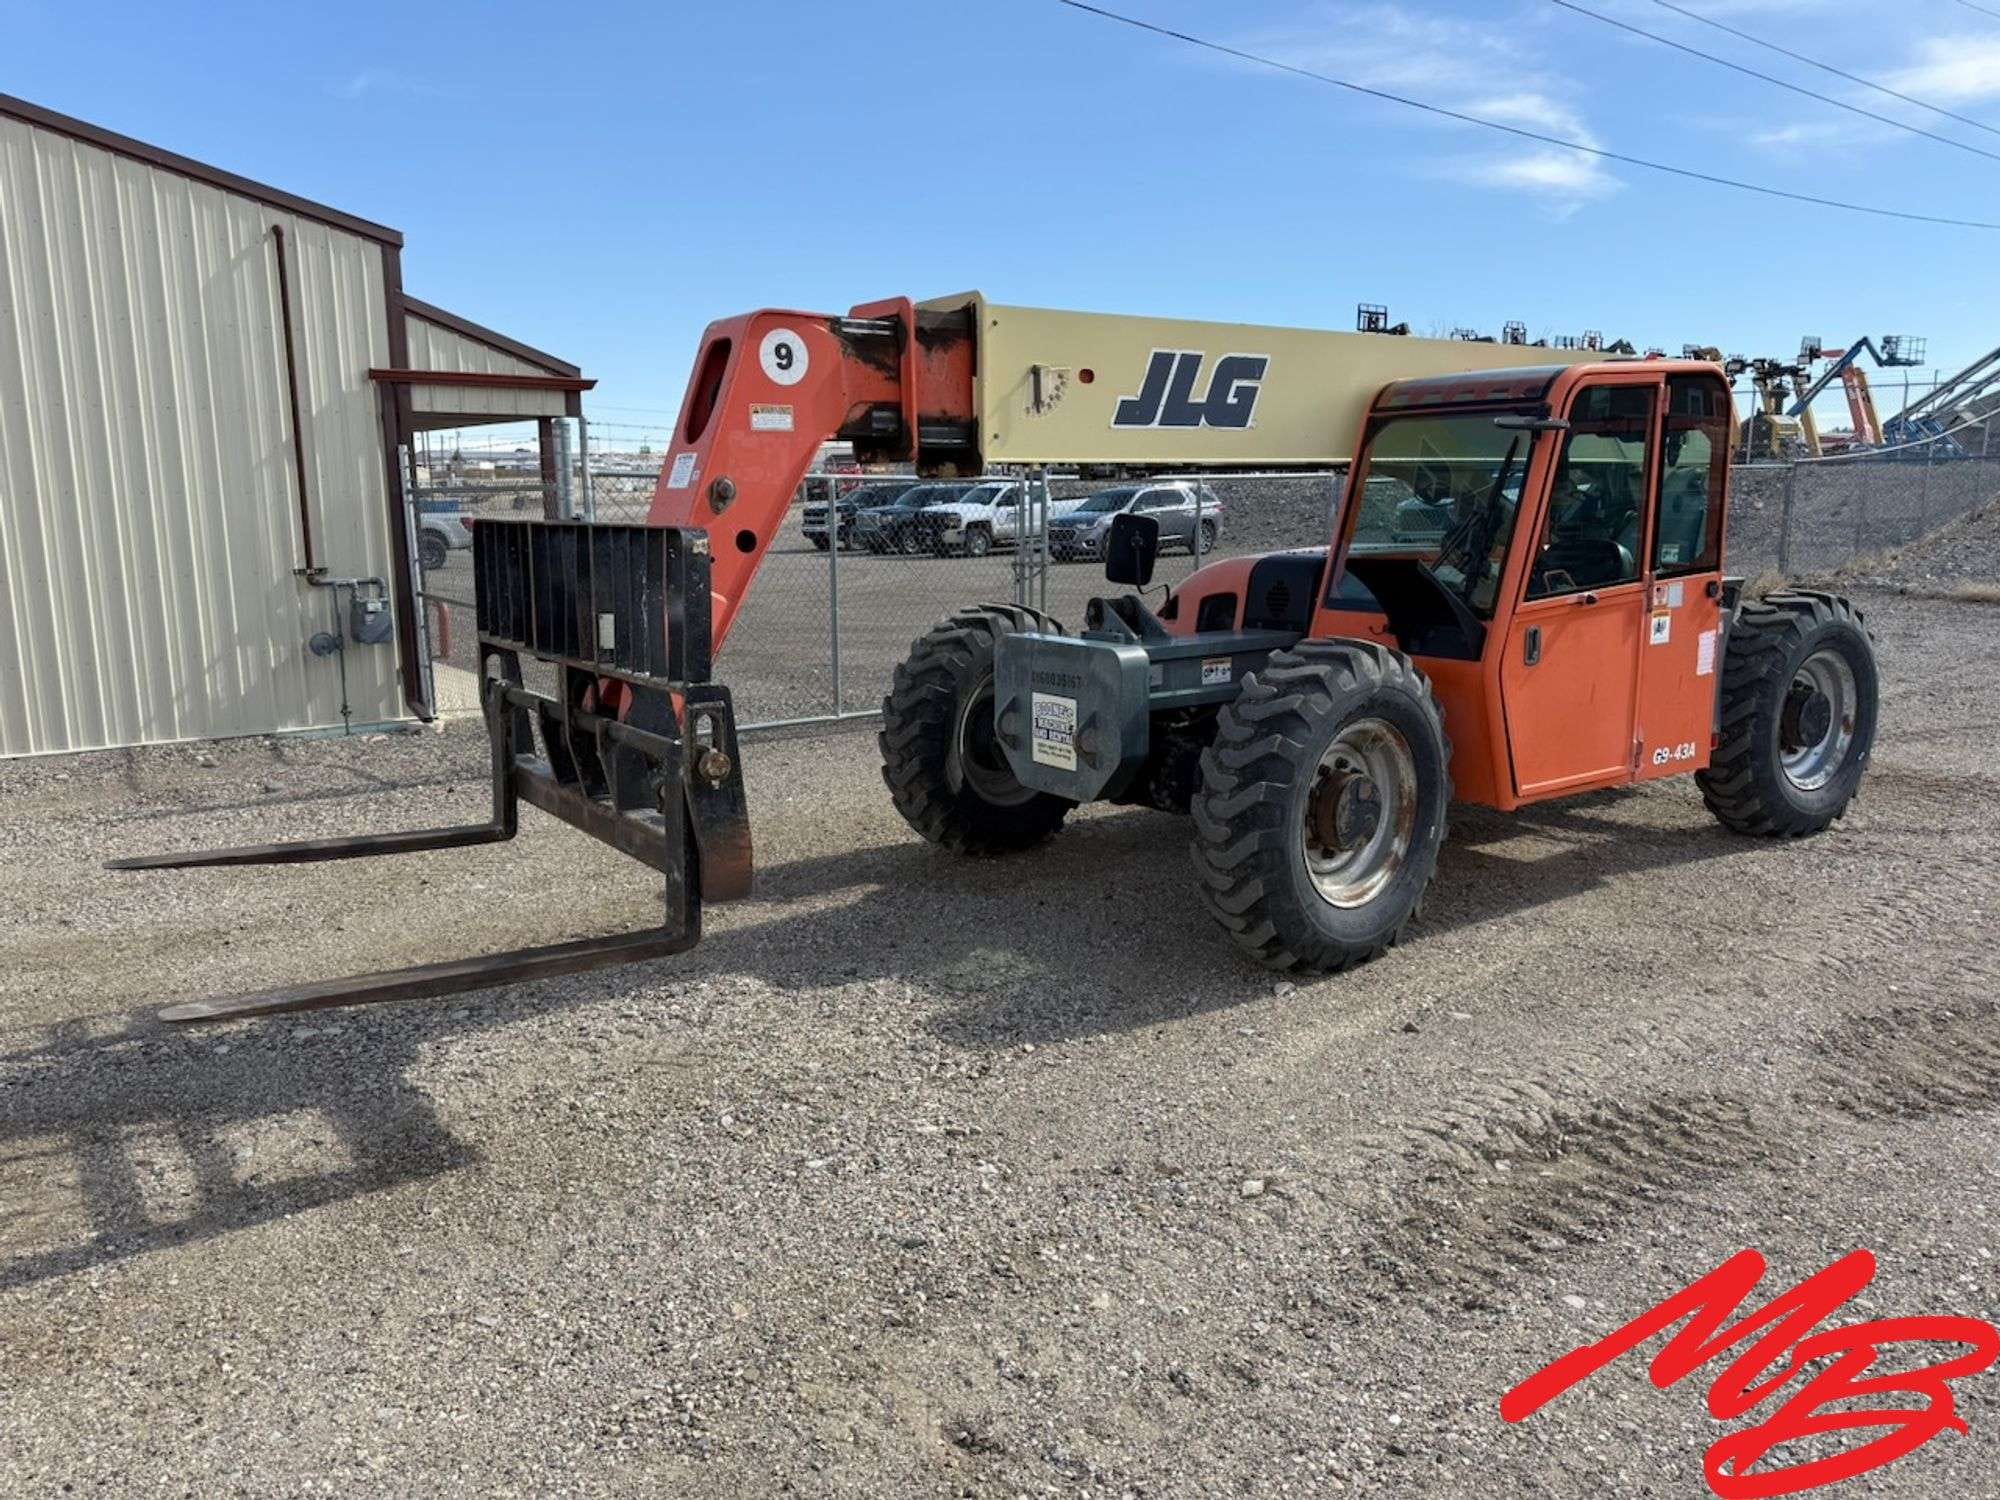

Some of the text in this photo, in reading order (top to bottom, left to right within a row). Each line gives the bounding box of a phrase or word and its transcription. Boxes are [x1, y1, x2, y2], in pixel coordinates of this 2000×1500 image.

[774, 342, 794, 370] 9
[1112, 348, 1270, 429] JLG
[1652, 741, 1696, 766] G9-43A
